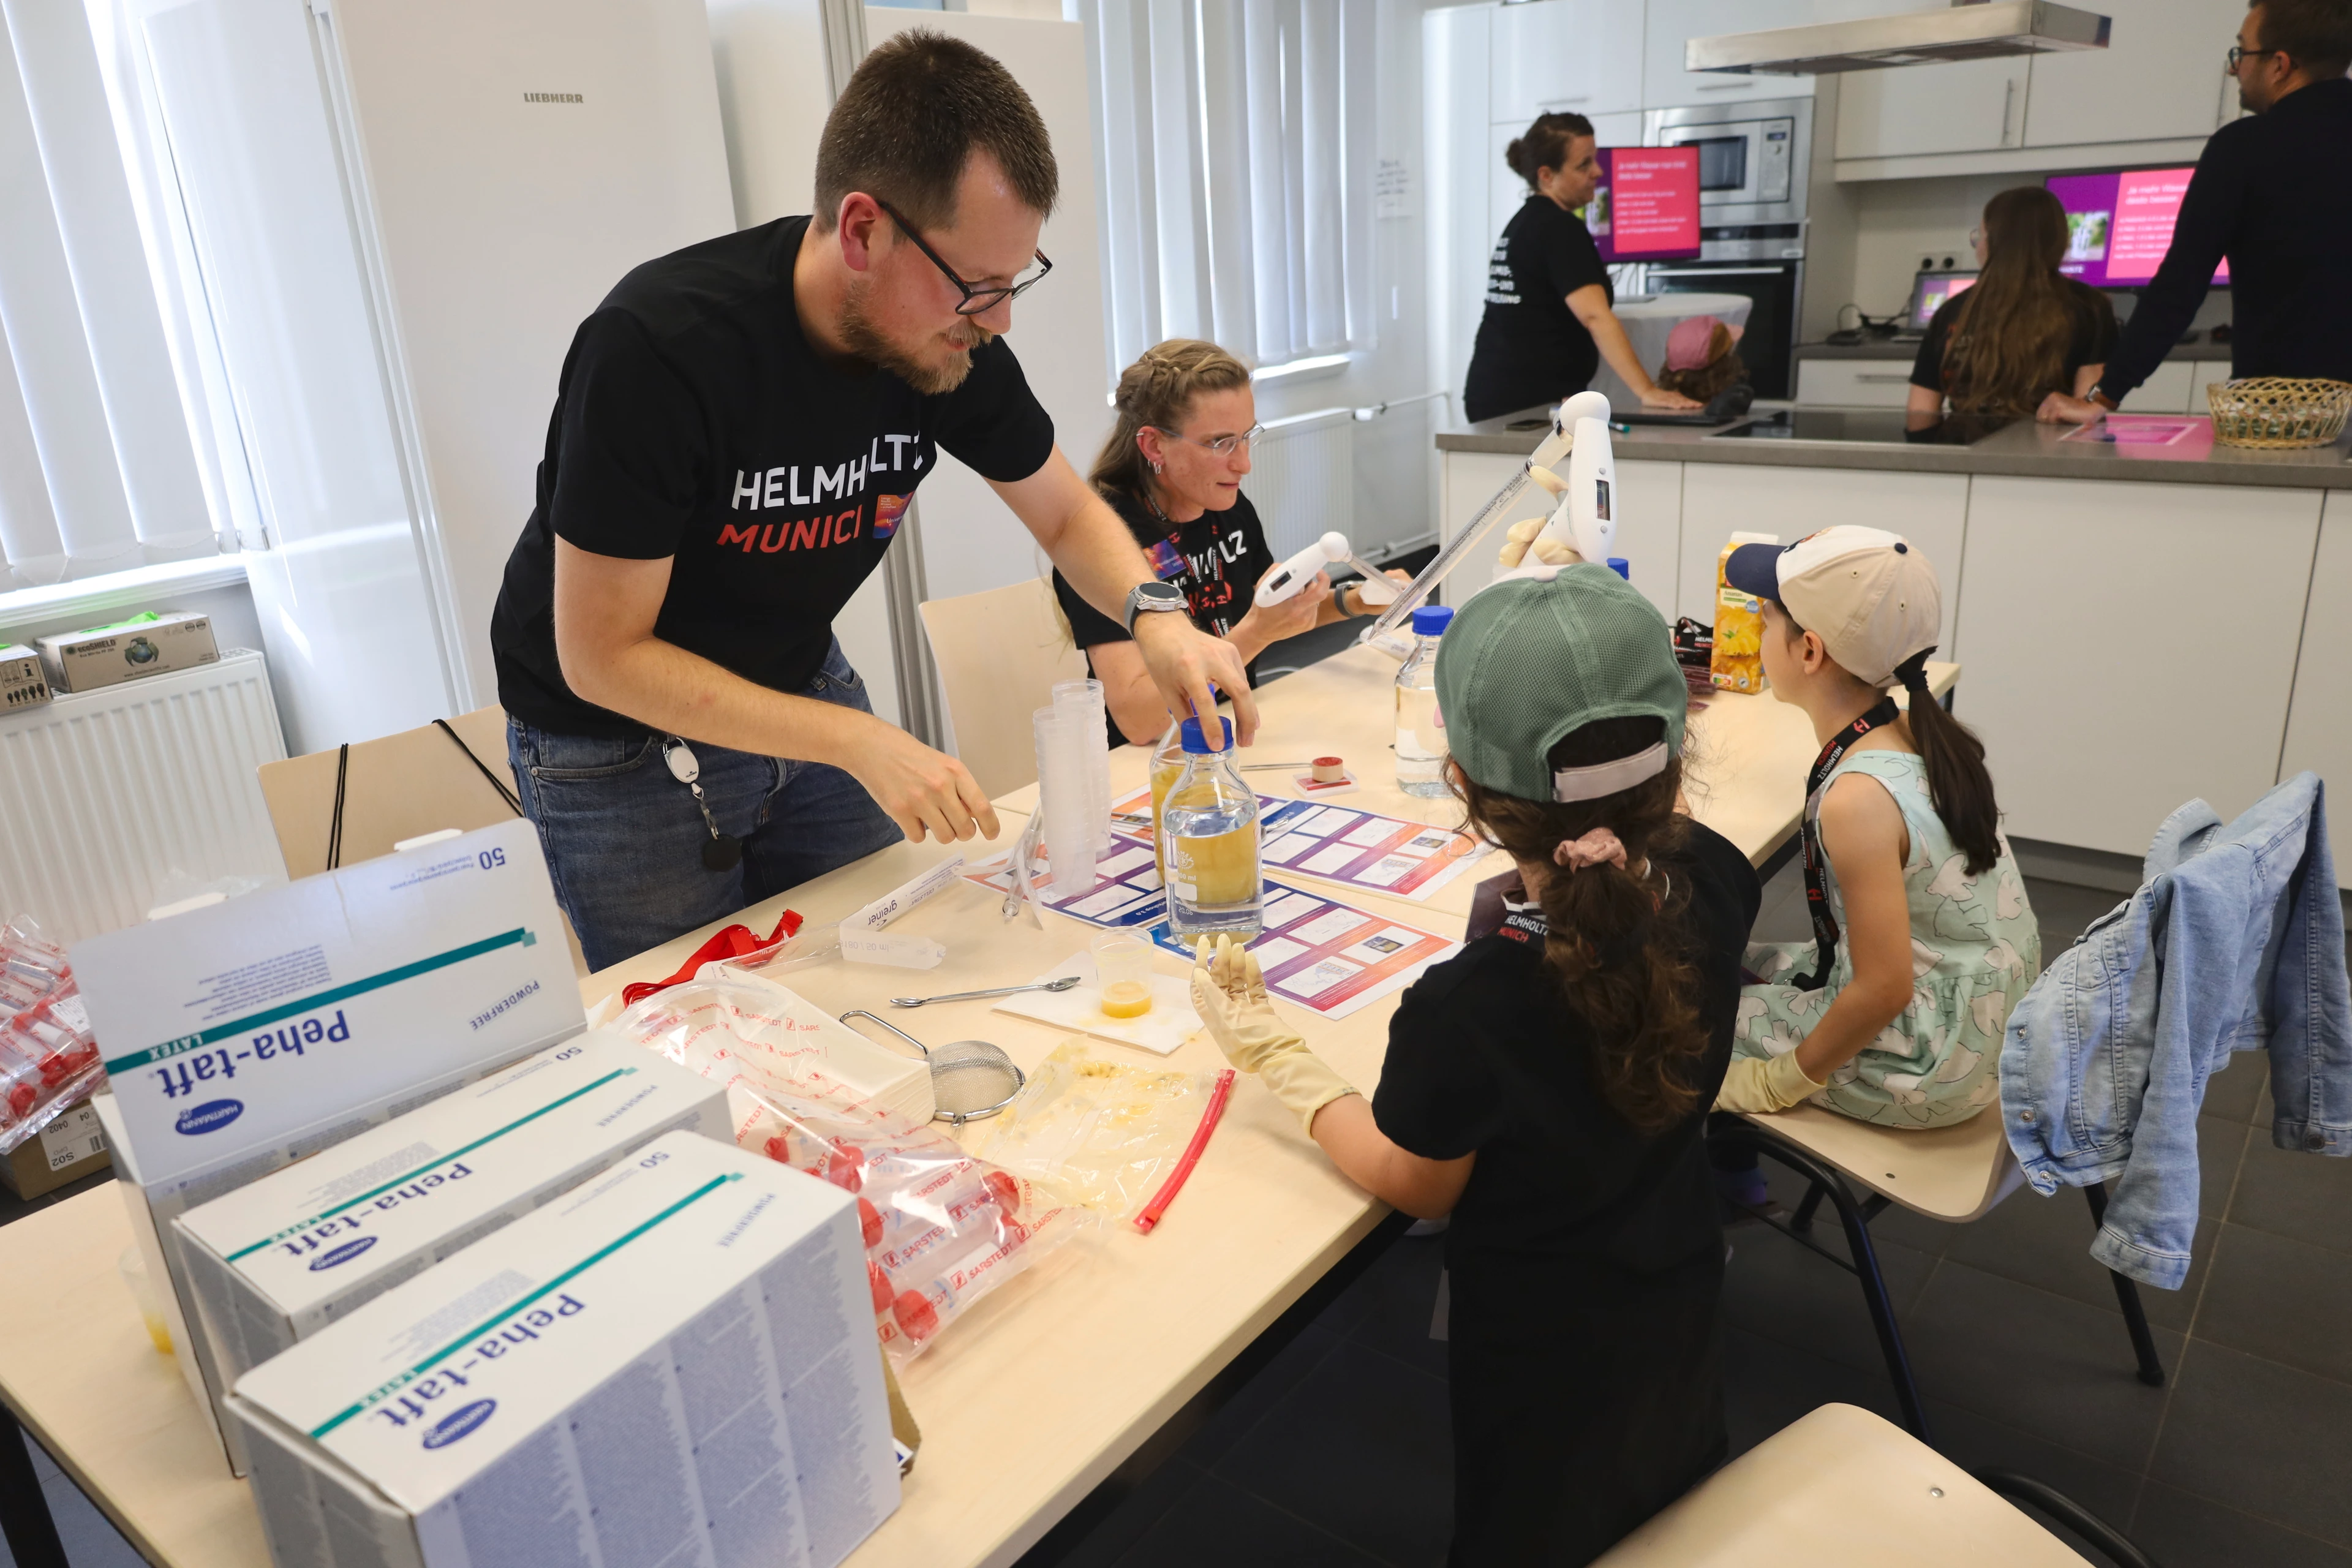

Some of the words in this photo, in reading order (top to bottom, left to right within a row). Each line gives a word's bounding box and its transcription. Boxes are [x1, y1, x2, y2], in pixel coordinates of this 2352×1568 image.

[524, 92, 584, 104] LIEBHERR
[731, 431, 924, 510] HELMHLT
[716, 505, 862, 553] MUNIC
[1186, 553, 1202, 584] HELMHOLTZ
[77, 639, 117, 652] ecoSHIELD
[1817, 740, 1836, 766] MUNICH
[1817, 745, 1844, 780] HELMHOLTZ
[479, 848, 506, 870] 50
[1177, 851, 1194, 862] IMAX
[868, 900, 897, 925] greiner
[1496, 926, 1529, 943] MUNICH
[469, 980, 540, 1031] POWDERFREE
[745, 1013, 782, 1027] SARSTEDT
[148, 1033, 204, 1061] LATEX
[556, 1046, 584, 1061] 50
[49, 1120, 69, 1134] 0402
[80, 1111, 90, 1121] 04
[181, 1104, 239, 1131] HARTMANN
[736, 1104, 765, 1144] RSTEDT
[51, 1152, 75, 1166] S02
[639, 1151, 670, 1169] 50
[914, 1171, 954, 1199] ARSTEDT
[902, 1225, 946, 1259] SARSTED
[968, 1242, 1013, 1280] SARSTEDT
